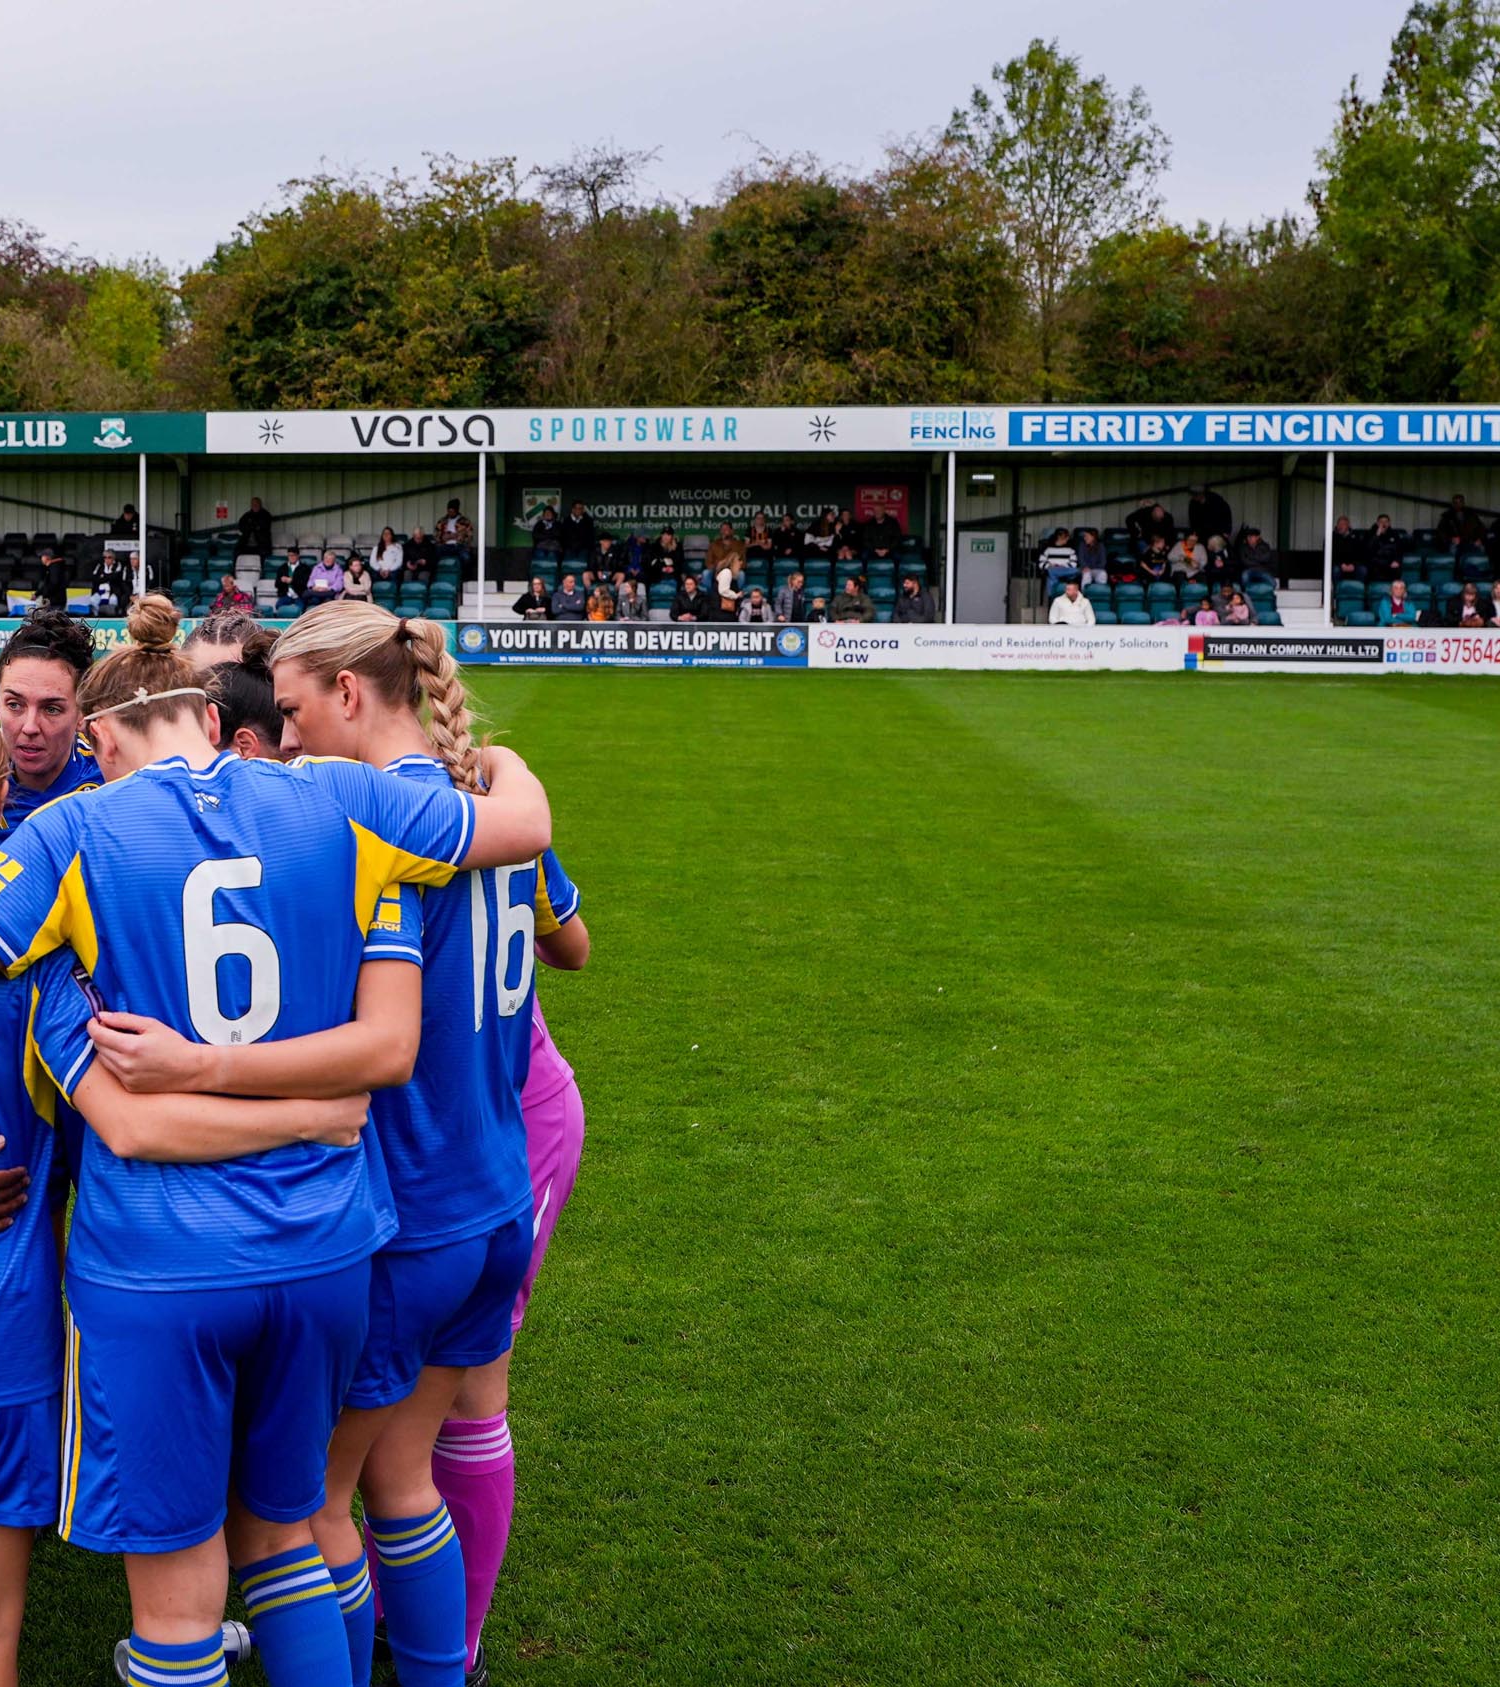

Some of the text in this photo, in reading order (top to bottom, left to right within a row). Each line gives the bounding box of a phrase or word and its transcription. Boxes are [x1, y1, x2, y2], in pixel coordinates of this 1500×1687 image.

[529, 416, 738, 442] SPORTSWEAR
[1022, 415, 1193, 442] FERRIBY
[1205, 414, 1384, 443] FENCING
[669, 489, 751, 500] WELCOME TO
[584, 504, 638, 518] NORTH
[642, 504, 705, 518] FERRIBY
[489, 629, 775, 651] YOUTH PLAYER DEVELOPMENT
[836, 636, 899, 650] Ancora
[913, 636, 1169, 651] Commercial and Residential Property Solicitors
[1386, 639, 1437, 650] 01482
[1208, 643, 1380, 657] THE DRAIN COMPANY HULL LTD
[835, 651, 869, 664] Law
[182, 854, 282, 1046] 6
[471, 859, 536, 1033] 16
